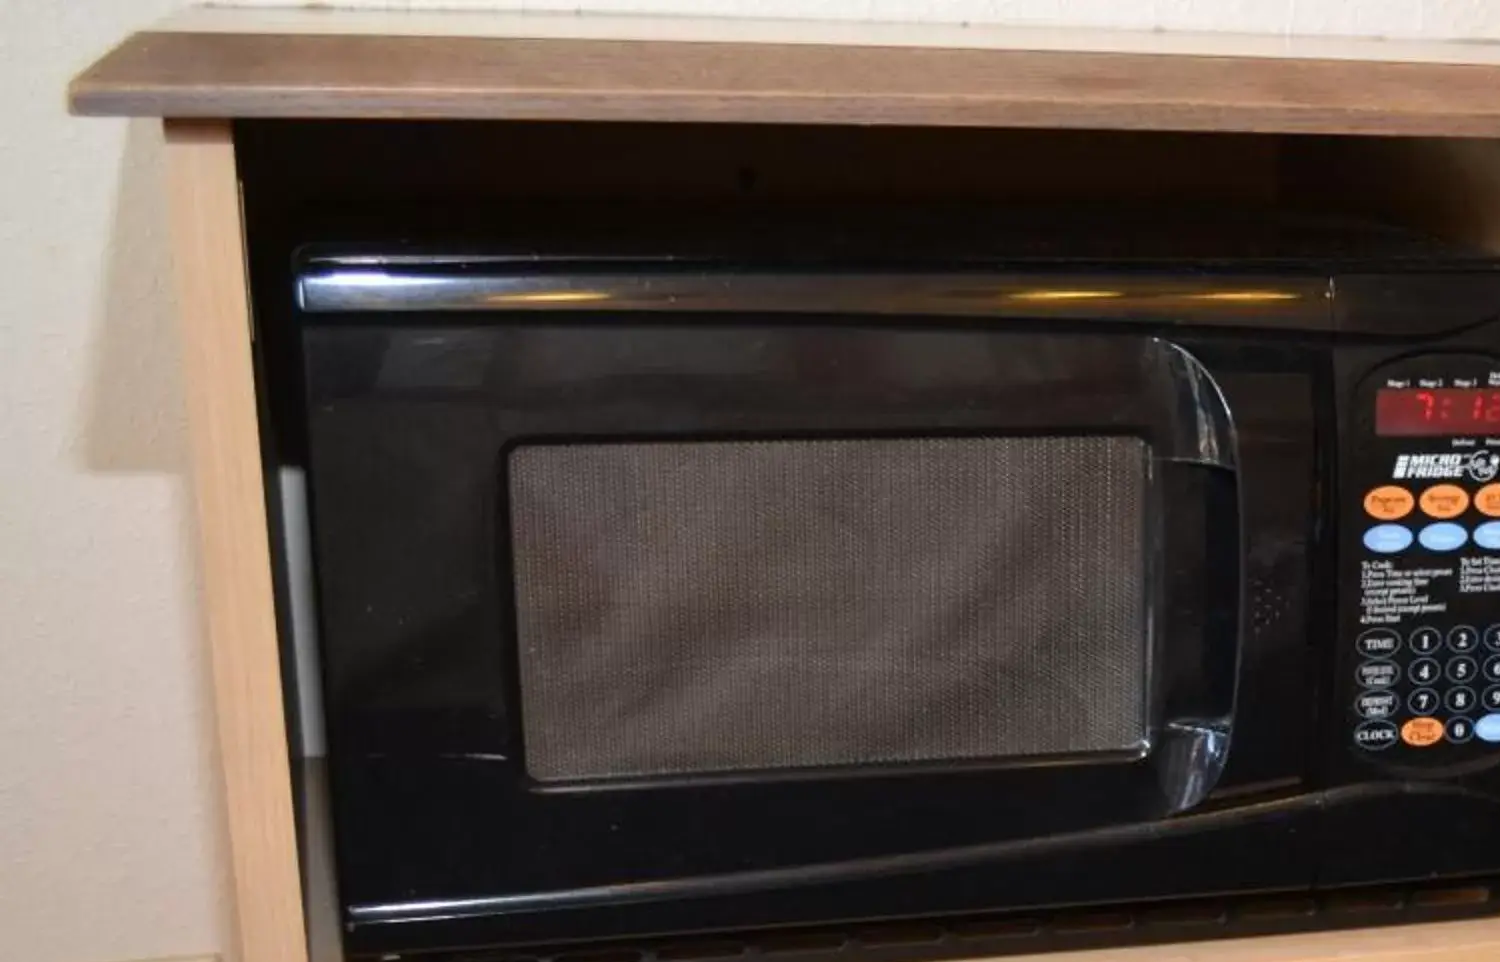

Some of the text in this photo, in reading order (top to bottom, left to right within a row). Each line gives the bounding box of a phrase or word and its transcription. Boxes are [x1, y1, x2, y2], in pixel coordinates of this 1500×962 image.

[1411, 454, 1461, 466] MICRO
[1407, 465, 1465, 478] FRIDGE
[1364, 637, 1394, 650] TIME
[1421, 634, 1429, 649] 1
[1456, 632, 1468, 647] 2
[1419, 664, 1430, 679] 4
[1456, 662, 1467, 678] 5
[1419, 694, 1429, 709] 7
[1455, 692, 1466, 707] 8
[1356, 728, 1396, 741] CLOCK
[1454, 723, 1465, 737] 0
